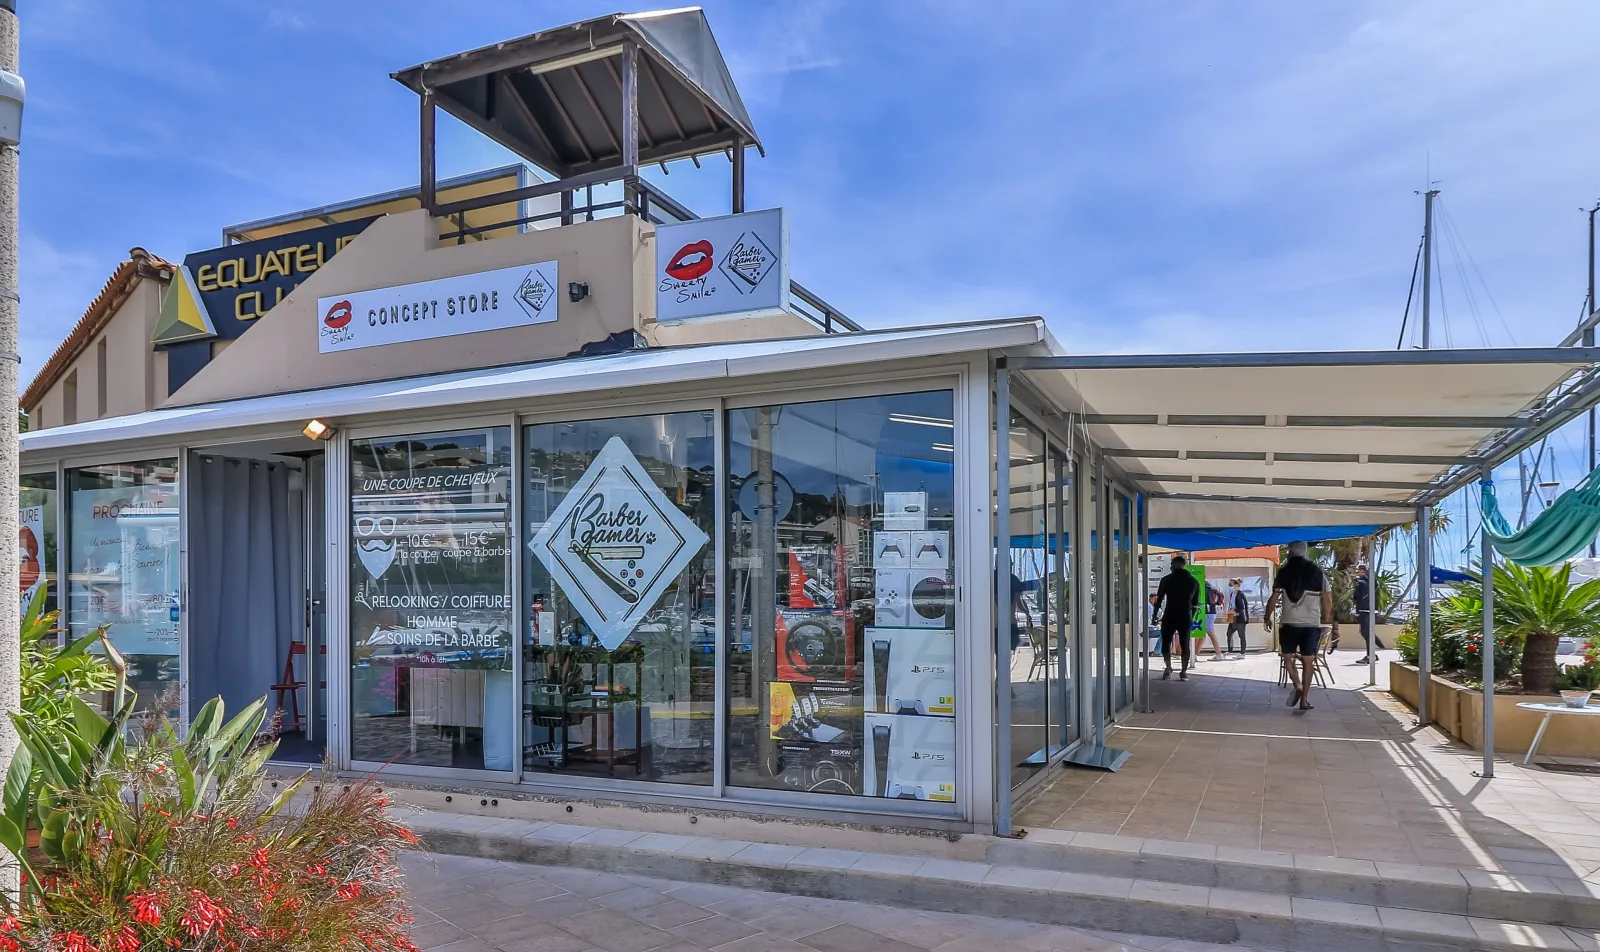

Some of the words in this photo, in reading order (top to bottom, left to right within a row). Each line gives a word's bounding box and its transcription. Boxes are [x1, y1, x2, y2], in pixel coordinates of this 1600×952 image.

[729, 243, 762, 264] Barber
[659, 271, 707, 295] Sweety
[676, 288, 712, 303] Smile
[368, 300, 437, 327] CONCEPT
[446, 290, 499, 316] STORE
[363, 479, 388, 491] UNE
[389, 476, 425, 490] COUPE
[426, 475, 443, 488] DE
[444, 471, 498, 487] CHEVEUX
[93, 501, 163, 519] PROCHAINE
[571, 493, 648, 539] Barber
[580, 526, 646, 554] gamer
[400, 549, 408, 559] la
[409, 550, 436, 560] coupe
[442, 548, 471, 560] coupe
[473, 547, 481, 557] &
[482, 545, 511, 557] barbe
[451, 595, 511, 608] COIFFURE
[407, 616, 458, 628] HOMME
[387, 633, 422, 646] SOINS
[425, 634, 441, 646] DE
[444, 634, 459, 646] LA
[462, 635, 499, 647] BARBE
[922, 753, 945, 761] PS5
